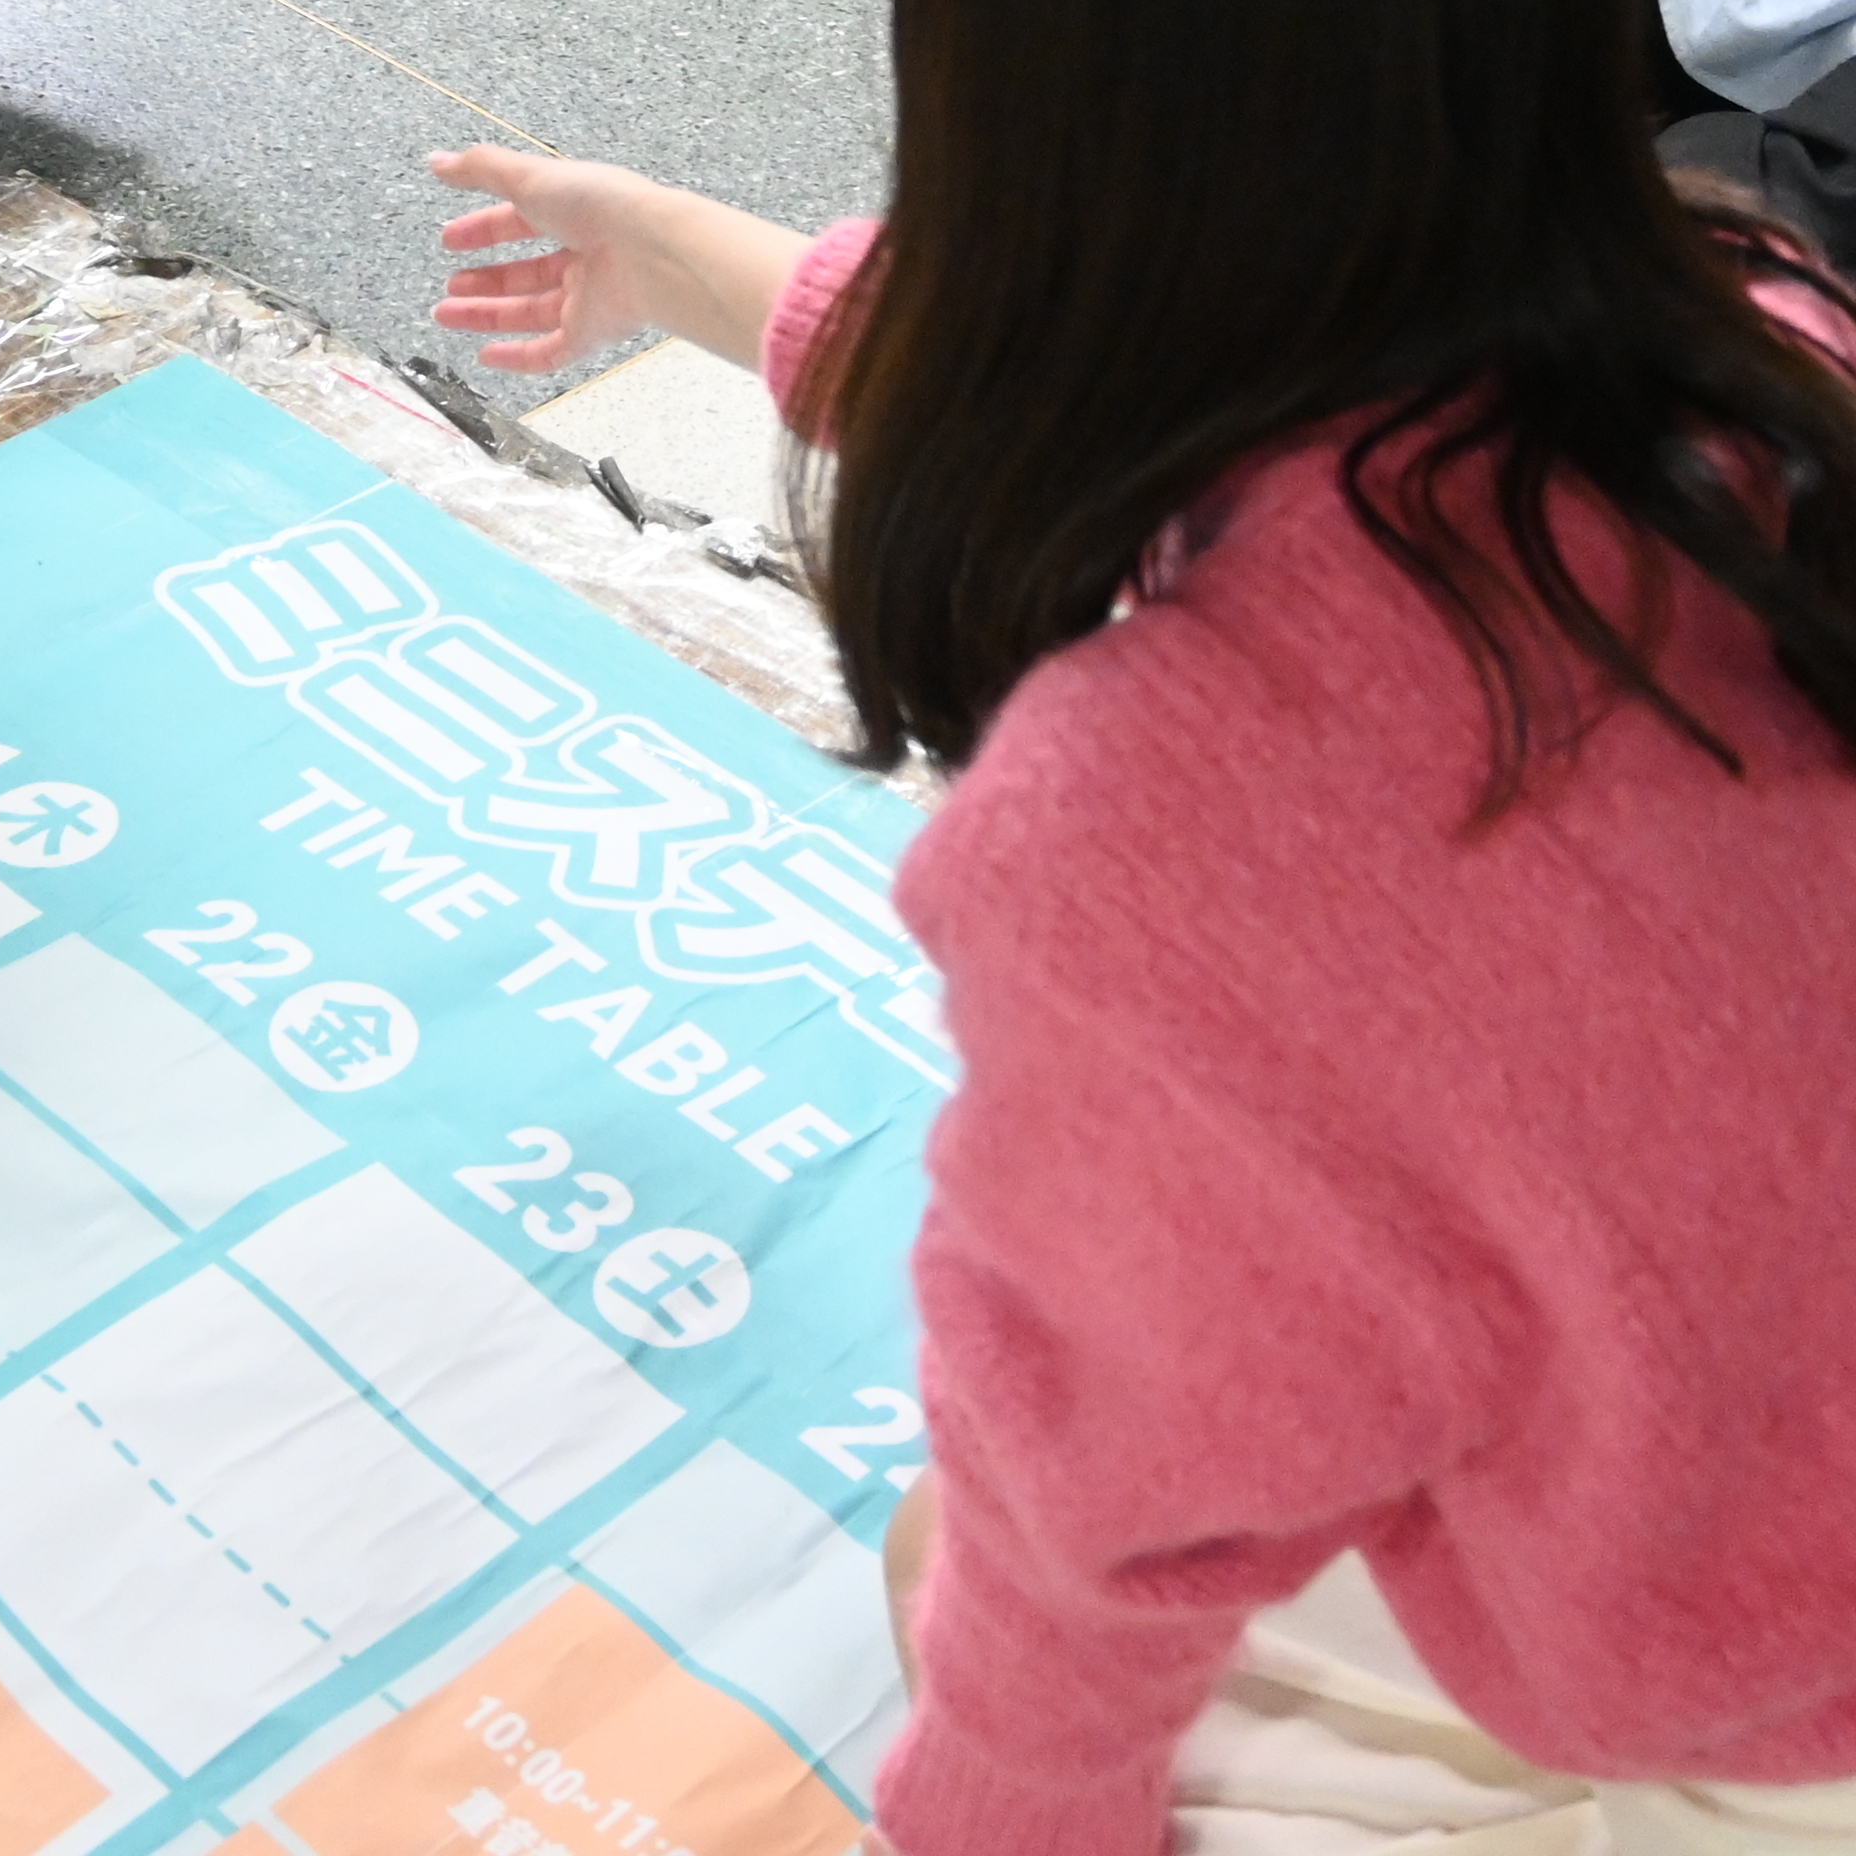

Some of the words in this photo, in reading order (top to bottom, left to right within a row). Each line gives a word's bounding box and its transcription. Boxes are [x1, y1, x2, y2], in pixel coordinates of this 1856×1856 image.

[154, 519, 959, 1094] ミニステ
[145, 899, 312, 1008] 22
[259, 766, 518, 940] TIME
[496, 919, 852, 1185] TABLE
[450, 1125, 639, 1256] 23
[799, 1386, 928, 1496] 2
